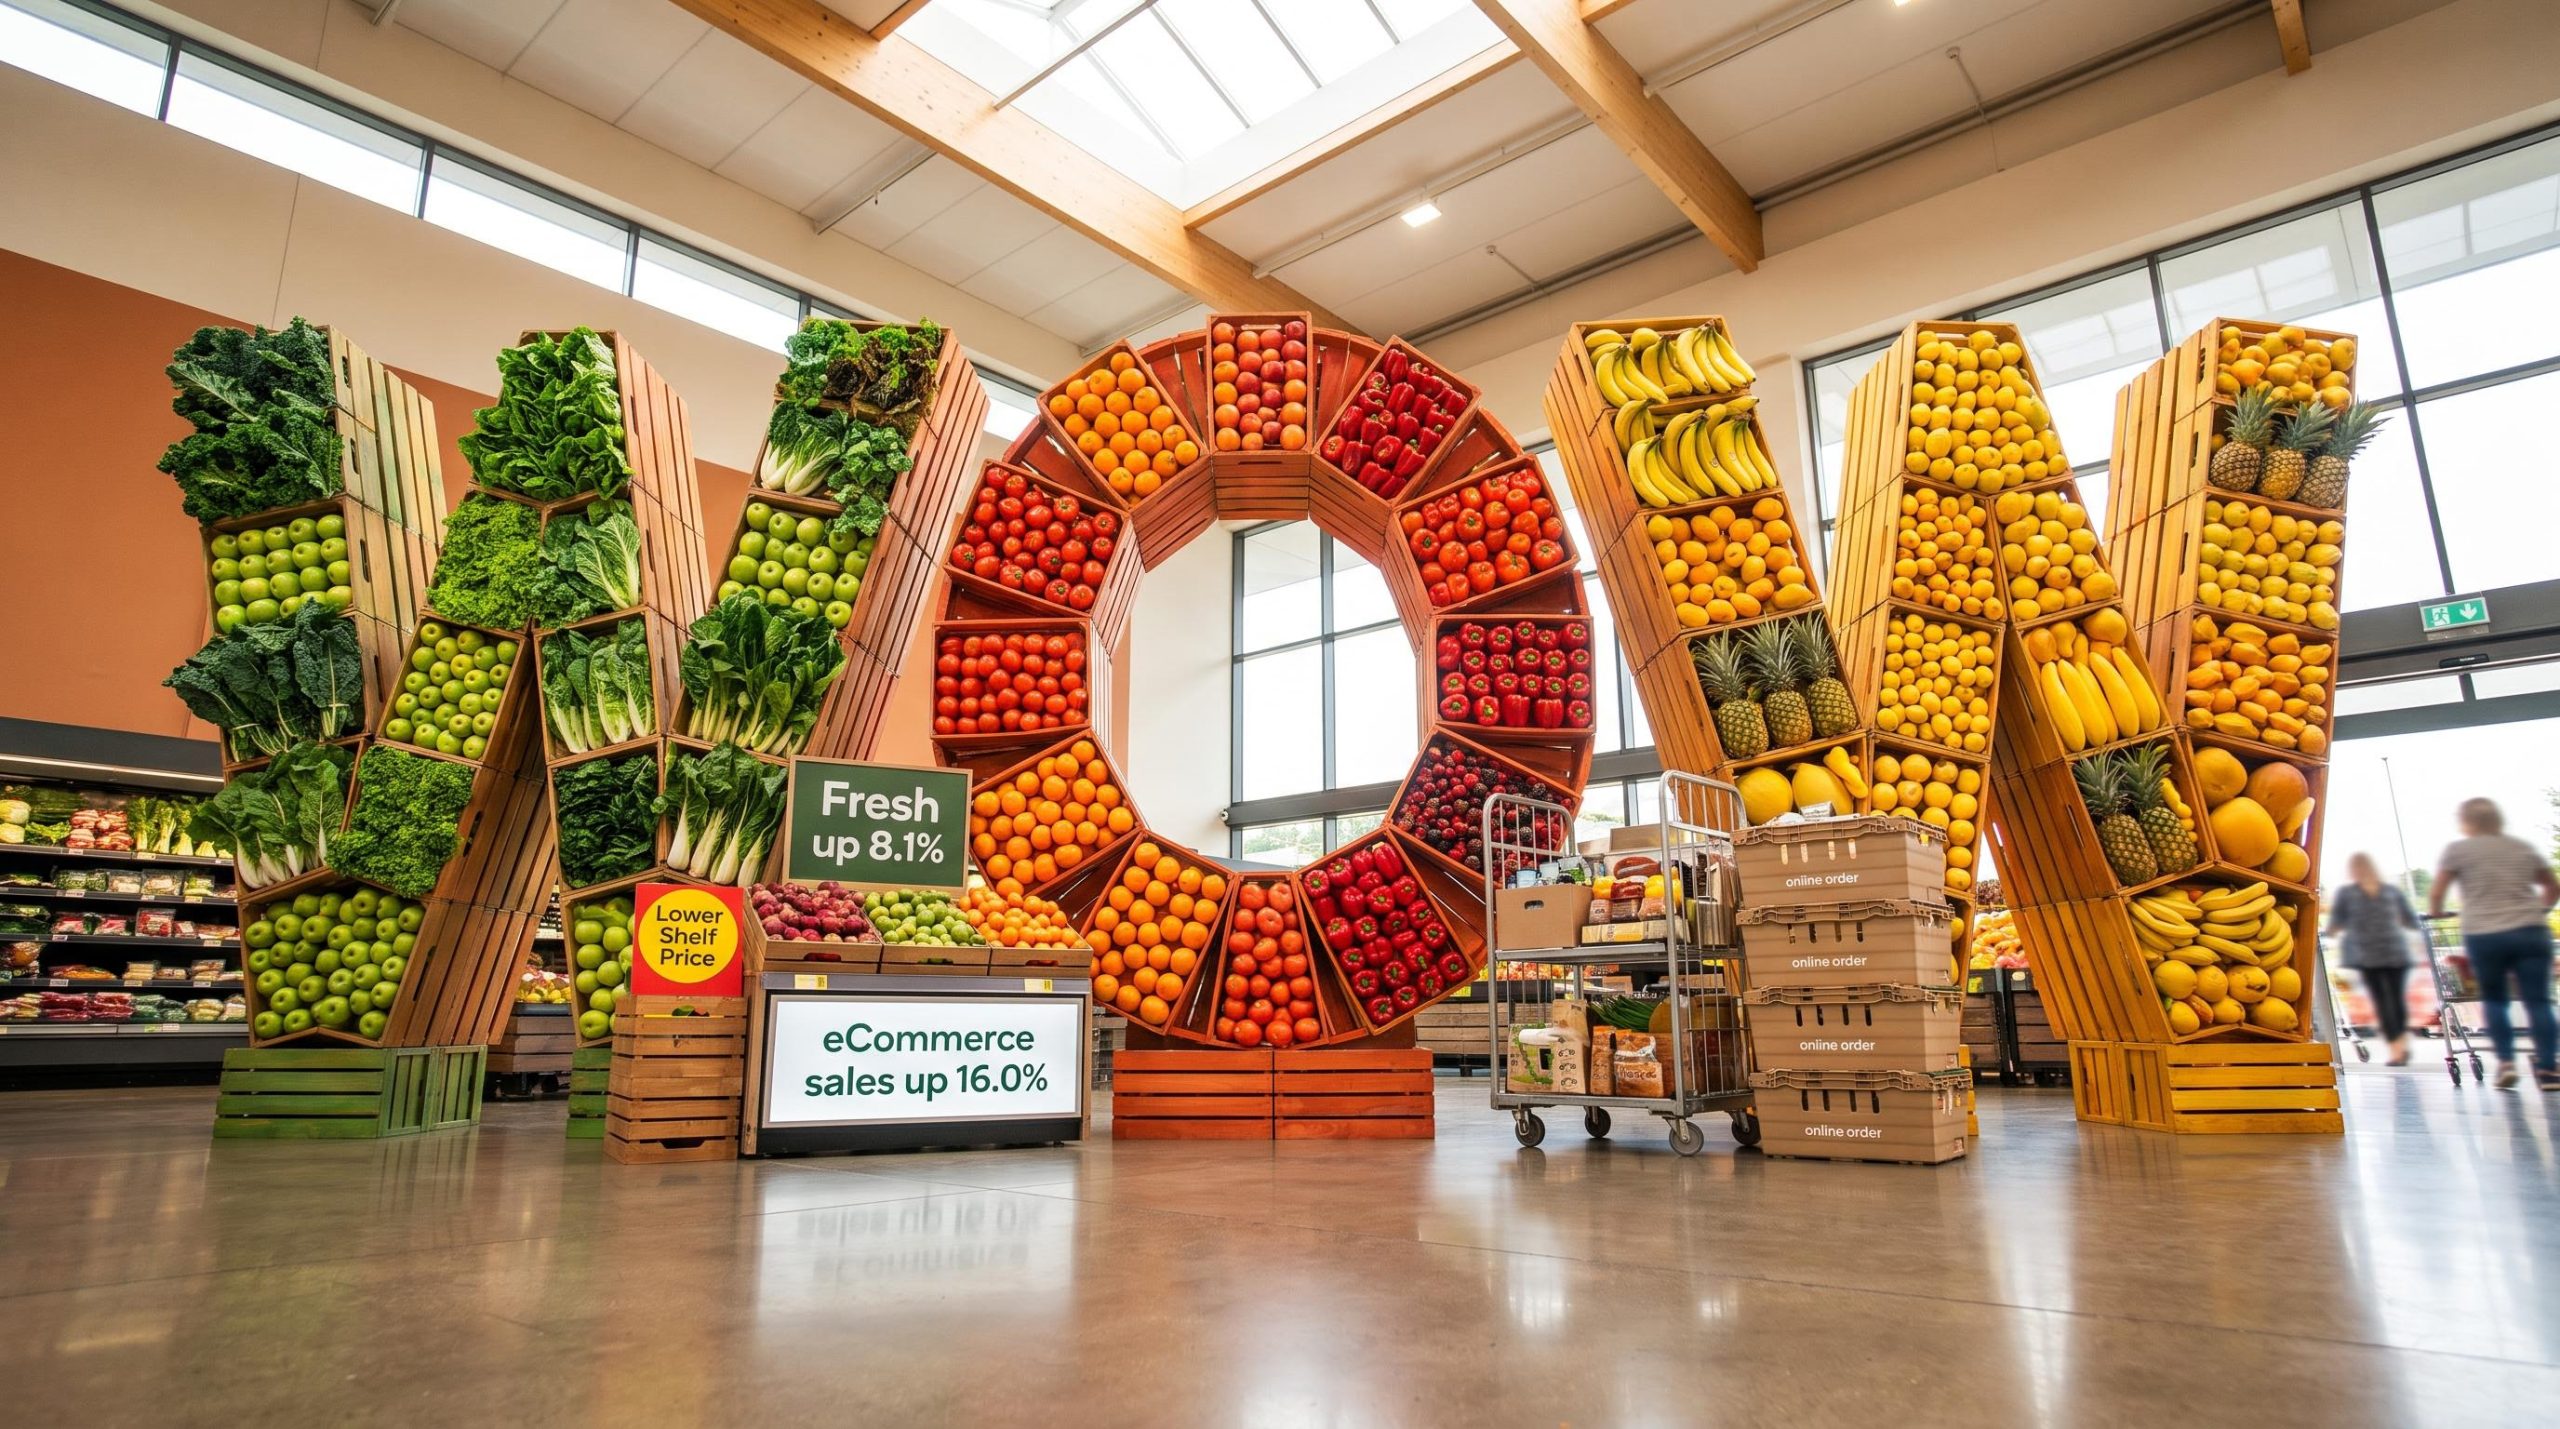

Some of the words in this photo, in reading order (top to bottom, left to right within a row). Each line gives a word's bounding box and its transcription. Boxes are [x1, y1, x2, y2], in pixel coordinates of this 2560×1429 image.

[822, 780, 939, 823] Fresh
[812, 835, 860, 866] up
[869, 830, 945, 864] 8.1%
[1824, 872, 1859, 885] order
[656, 905, 724, 924] Lower
[660, 927, 718, 945] Shelf
[660, 948, 715, 967] Price
[1791, 955, 1830, 969] online
[1832, 954, 1868, 968] order
[823, 1022, 1035, 1053] eCommerce
[1799, 1038, 1839, 1051] online
[1840, 1038, 1876, 1051] order
[804, 1065, 895, 1097] sales
[905, 1072, 948, 1102] up
[956, 1063, 1048, 1093] 16.0%
[1804, 1123, 1845, 1137] online
[1846, 1125, 1882, 1140] order
